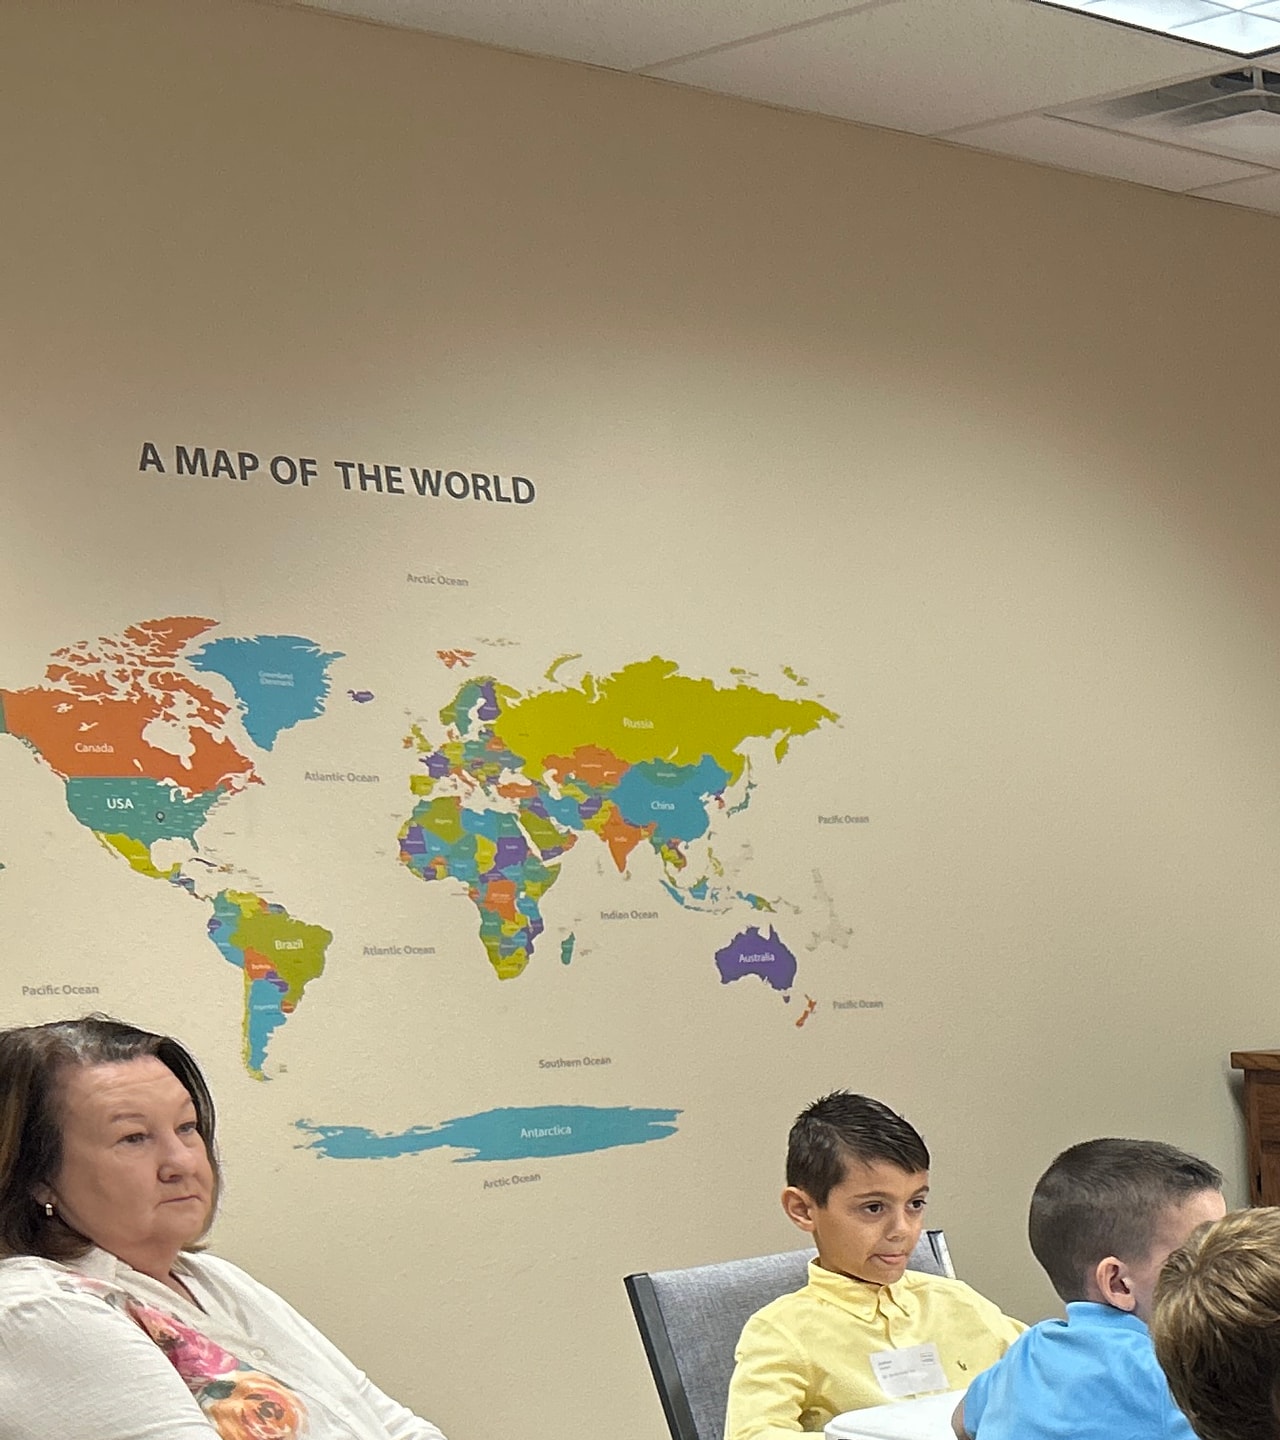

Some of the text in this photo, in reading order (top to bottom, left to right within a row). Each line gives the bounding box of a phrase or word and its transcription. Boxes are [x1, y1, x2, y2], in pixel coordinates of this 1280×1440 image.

[139, 442, 536, 505] A MAP OF THE WORLD
[406, 573, 469, 587] Arctic Ocean
[623, 717, 654, 729] Russia
[75, 742, 114, 754] Canada
[305, 771, 379, 783] Atlantic Ocean
[107, 798, 134, 810] USA
[651, 800, 675, 811] China
[818, 815, 869, 824] Pacific Ocean
[601, 911, 658, 920] Indian Ocean
[275, 939, 304, 950] Brazil
[363, 945, 436, 956] Atlantic Ocean
[739, 952, 775, 963] Australia
[22, 984, 99, 996] Pacific Ocean
[833, 1000, 883, 1009] Pacific Ocean
[538, 1056, 611, 1069] Southern Ocean
[520, 1125, 572, 1139] Antarctica
[483, 1173, 541, 1189] Arctic Ocean
